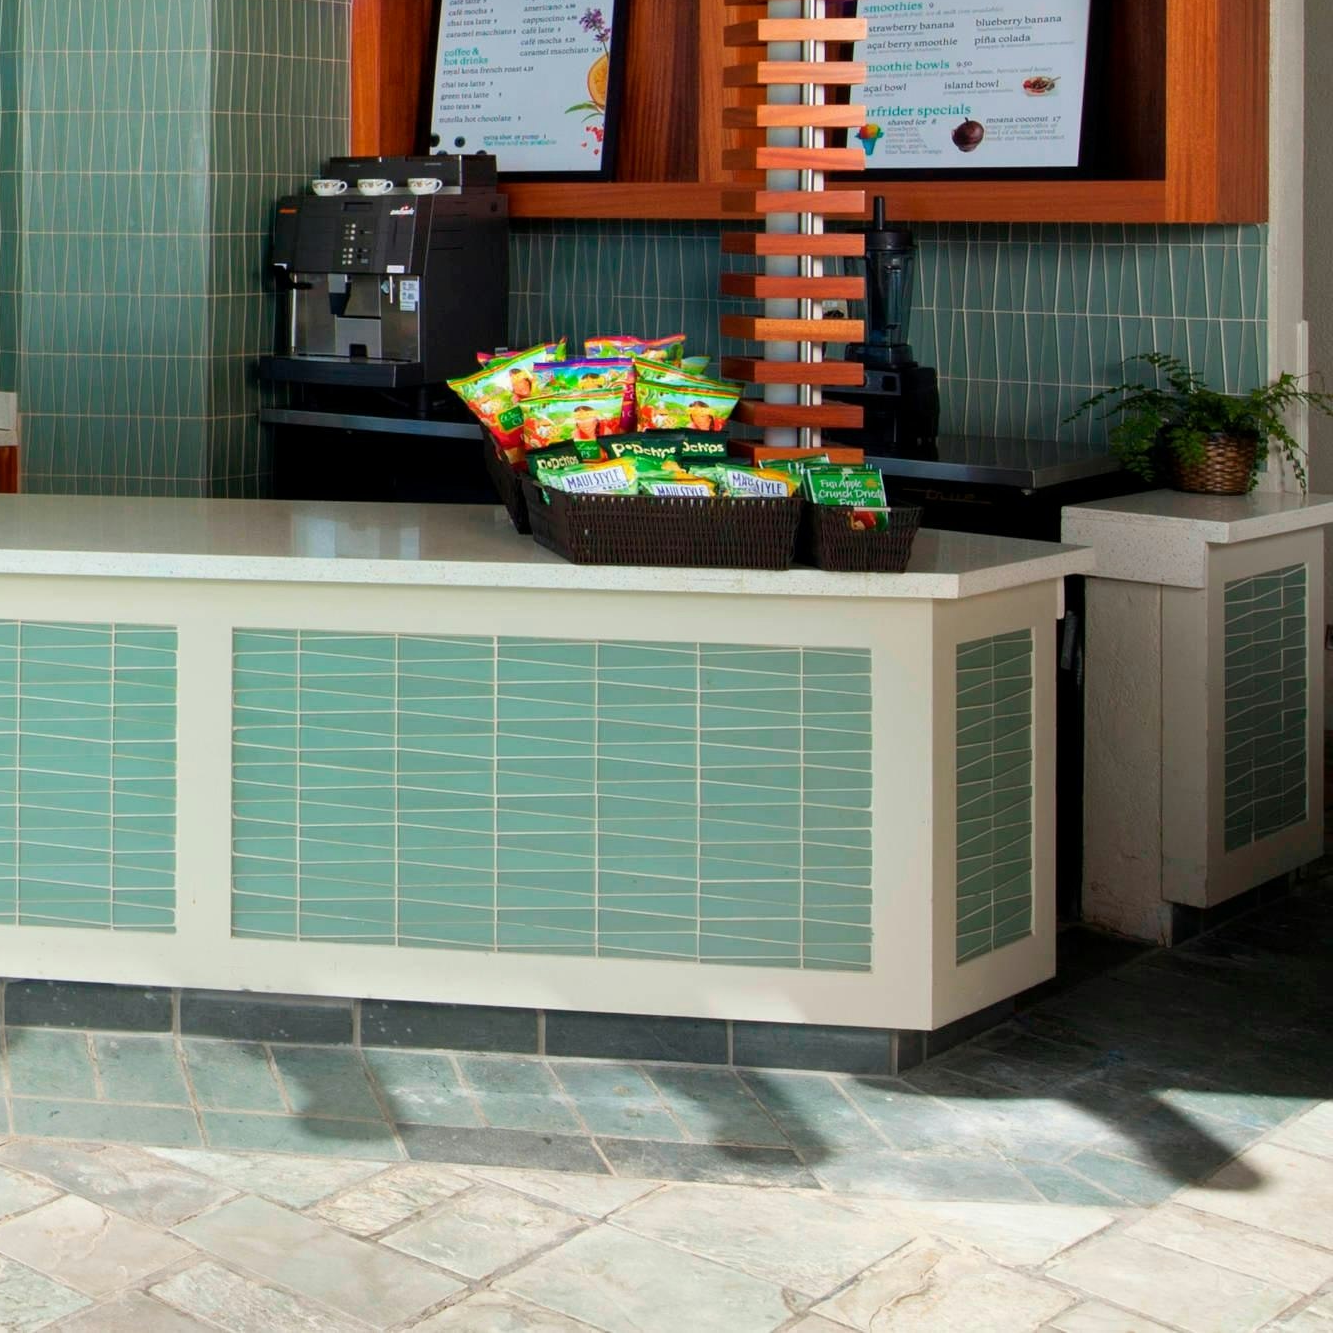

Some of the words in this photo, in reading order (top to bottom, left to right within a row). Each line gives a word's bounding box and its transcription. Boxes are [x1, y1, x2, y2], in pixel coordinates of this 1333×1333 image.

[524, 4, 562, 12] americano
[863, 2, 923, 13] smoothies
[523, 15, 565, 24] cappuccino
[975, 17, 1022, 28] blueberry
[1025, 14, 1062, 24] banana
[868, 22, 917, 33] strawberry
[920, 20, 954, 29] banana
[446, 30, 474, 38] caramel
[476, 29, 512, 37] macchiato
[998, 34, 1031, 43] colada
[888, 40, 912, 49] berry
[914, 37, 958, 47] smoothie
[444, 49, 470, 57] coffee
[520, 48, 549, 57] caramel
[550, 47, 588, 55] macchiato
[444, 58, 458, 66] hot
[460, 56, 488, 65] drinks
[915, 58, 950, 70] bowls
[443, 68, 459, 76] royal
[480, 66, 502, 74] french
[884, 83, 907, 92] bowl
[944, 81, 973, 89] island
[976, 80, 999, 89] bowl
[918, 103, 971, 118] specials
[888, 118, 913, 126] shaved
[986, 116, 1013, 124] moana
[1015, 115, 1048, 123] coconut
[611, 443, 676, 458] popchips
[566, 475, 594, 489] MAUI
[593, 469, 621, 486] STYLE
[839, 480, 862, 490] Apple
[657, 486, 681, 496] MAUI
[682, 486, 709, 496] STYLE
[819, 489, 853, 498] Crunch
[855, 490, 883, 498] Dried
